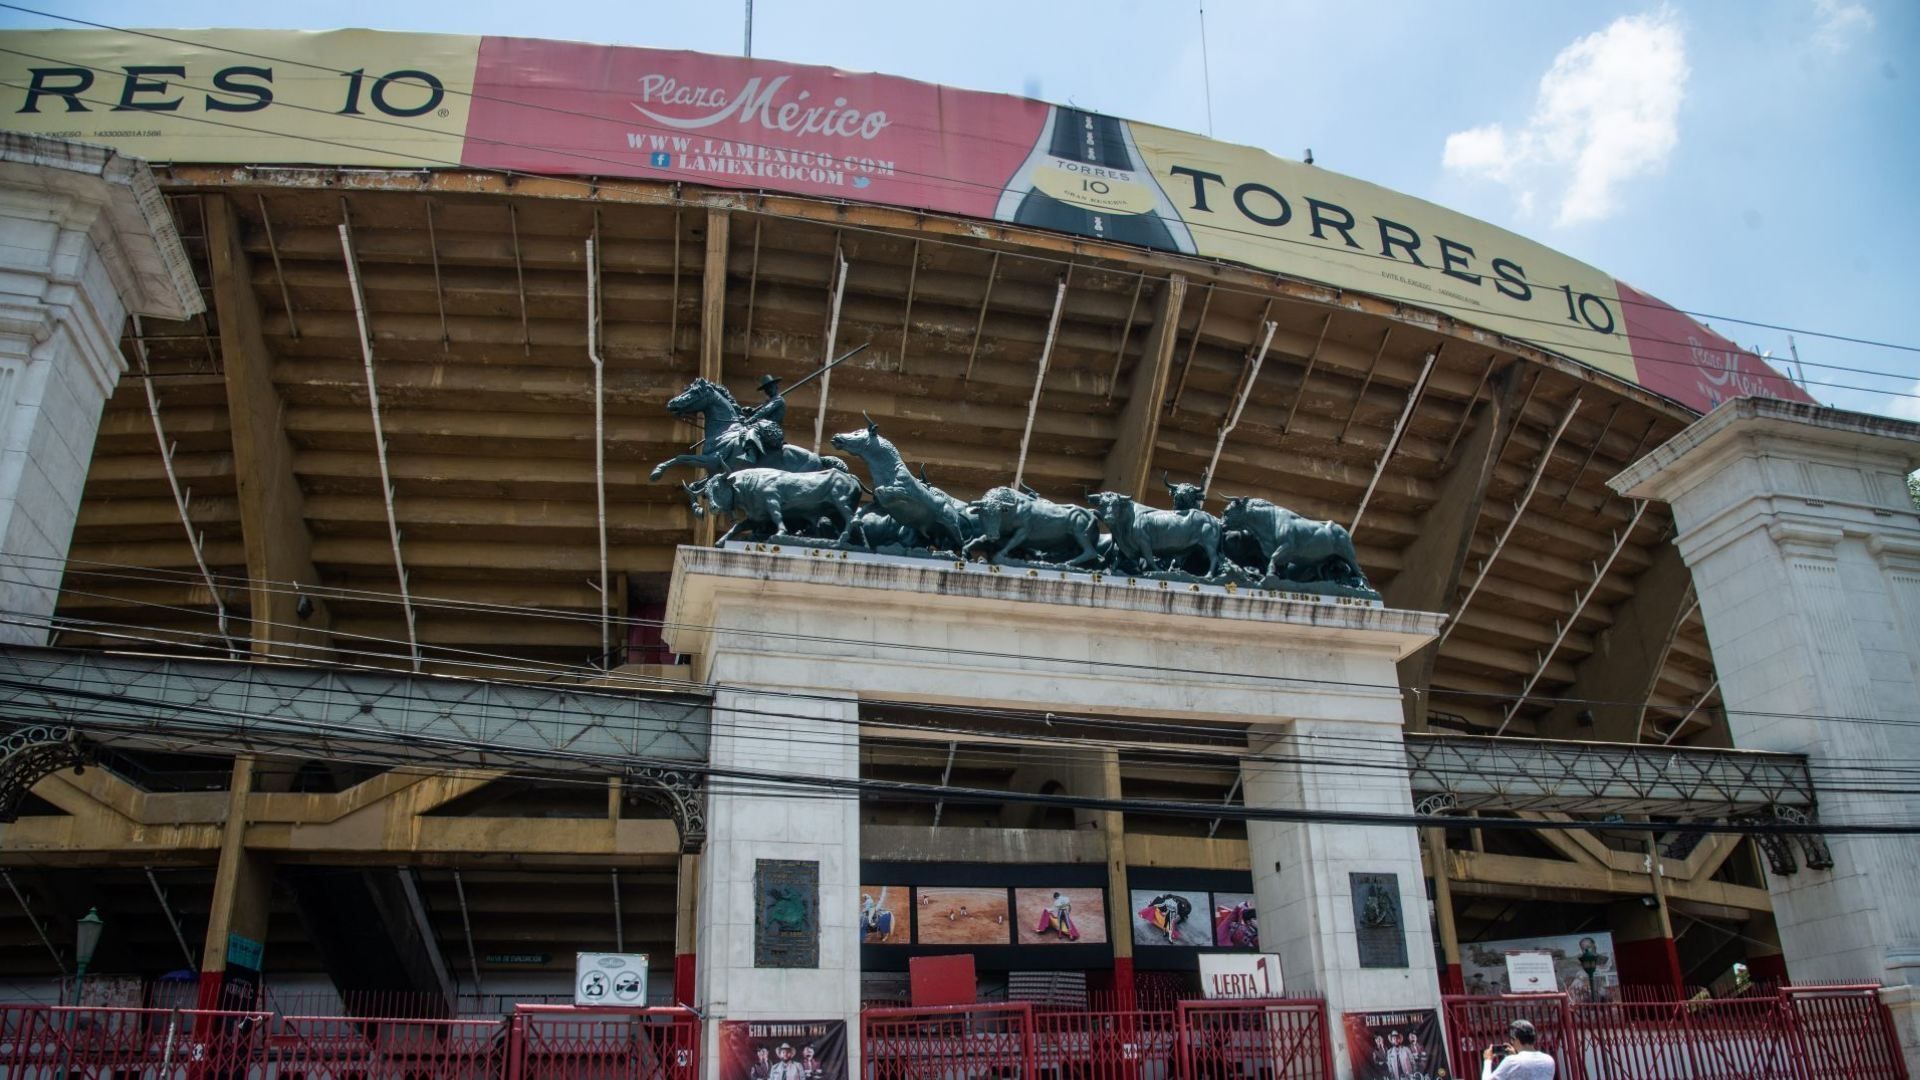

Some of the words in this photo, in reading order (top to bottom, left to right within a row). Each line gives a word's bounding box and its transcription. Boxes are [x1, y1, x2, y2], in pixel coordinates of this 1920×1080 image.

[15, 65, 274, 114] RES
[336, 68, 445, 117] 10
[638, 73, 728, 107] Plaza
[722, 75, 892, 140] México
[626, 132, 896, 177] WWW.LAMEXICO.COM
[677, 154, 845, 186] LAMEXICOCOM
[1057, 160, 1130, 181] TORRES
[1083, 179, 1110, 194] 10
[1169, 164, 1533, 302] TORRES
[1561, 284, 1616, 335] 10
[1212, 973, 1258, 995] UERTA
[1256, 957, 1271, 994] 1
[748, 1024, 768, 1038] GIRA
[770, 1024, 806, 1038] MUNDIAL
